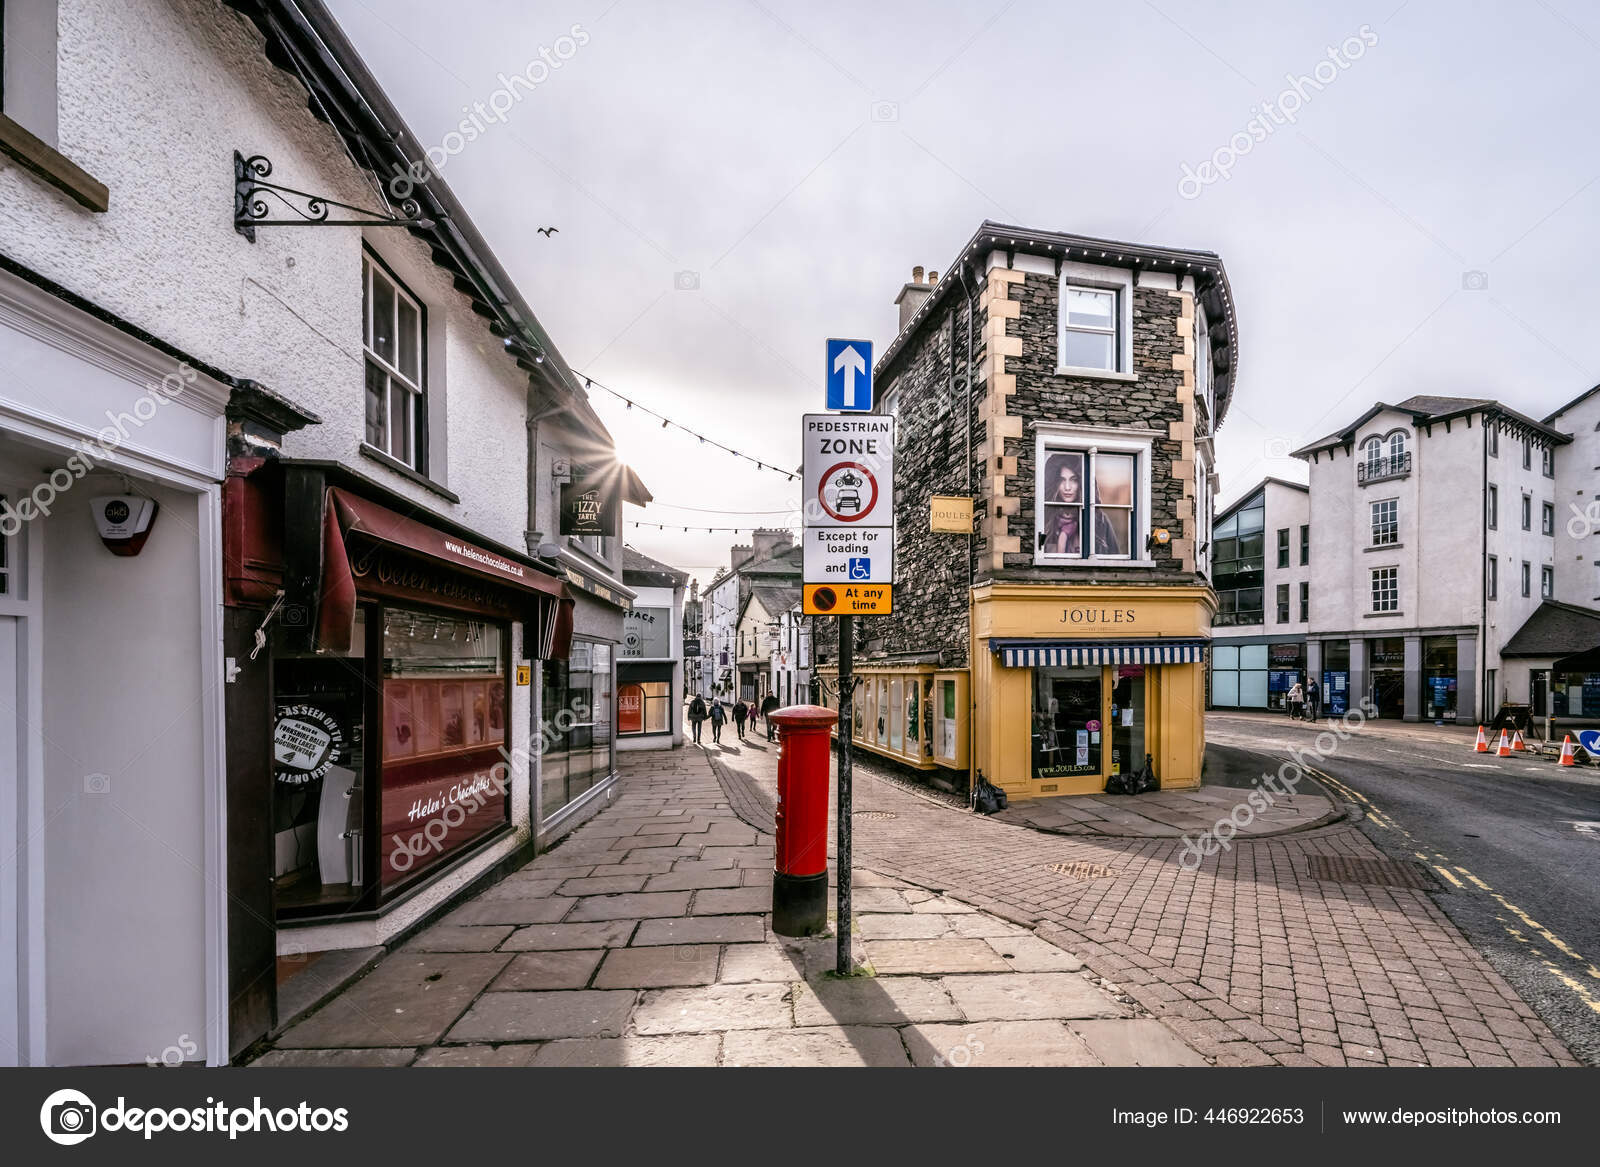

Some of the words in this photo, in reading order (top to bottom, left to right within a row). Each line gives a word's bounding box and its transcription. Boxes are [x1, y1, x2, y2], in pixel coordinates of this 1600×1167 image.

[808, 422, 890, 433] PEDESTRIAN
[820, 439, 878, 455] ZONE
[572, 501, 602, 514] FIZZY
[935, 511, 971, 520] JOULES
[817, 531, 858, 543] Except
[862, 530, 879, 541] for
[827, 543, 869, 555] loading
[445, 540, 524, 577] www.helenschocolates.co.uk
[825, 562, 847, 573] and
[845, 588, 860, 598] At
[863, 589, 883, 600] any
[851, 600, 877, 610] time
[1060, 609, 1135, 623] JOULES
[285, 705, 300, 717] AS
[301, 706, 327, 721] SEEN
[323, 717, 338, 731] ON
[279, 725, 310, 741] YORKSHIRE
[310, 736, 326, 747] DALES
[331, 729, 343, 742] TV
[274, 737, 317, 758] DOCUMENTARY
[288, 735, 299, 744] THE
[299, 739, 317, 751] LAKES
[328, 748, 342, 762] AS
[310, 761, 334, 780] SEEN
[278, 772, 294, 783] TV
[295, 773, 310, 784] ON
[408, 792, 447, 823] Helen's
[449, 777, 491, 805] Chocolates
